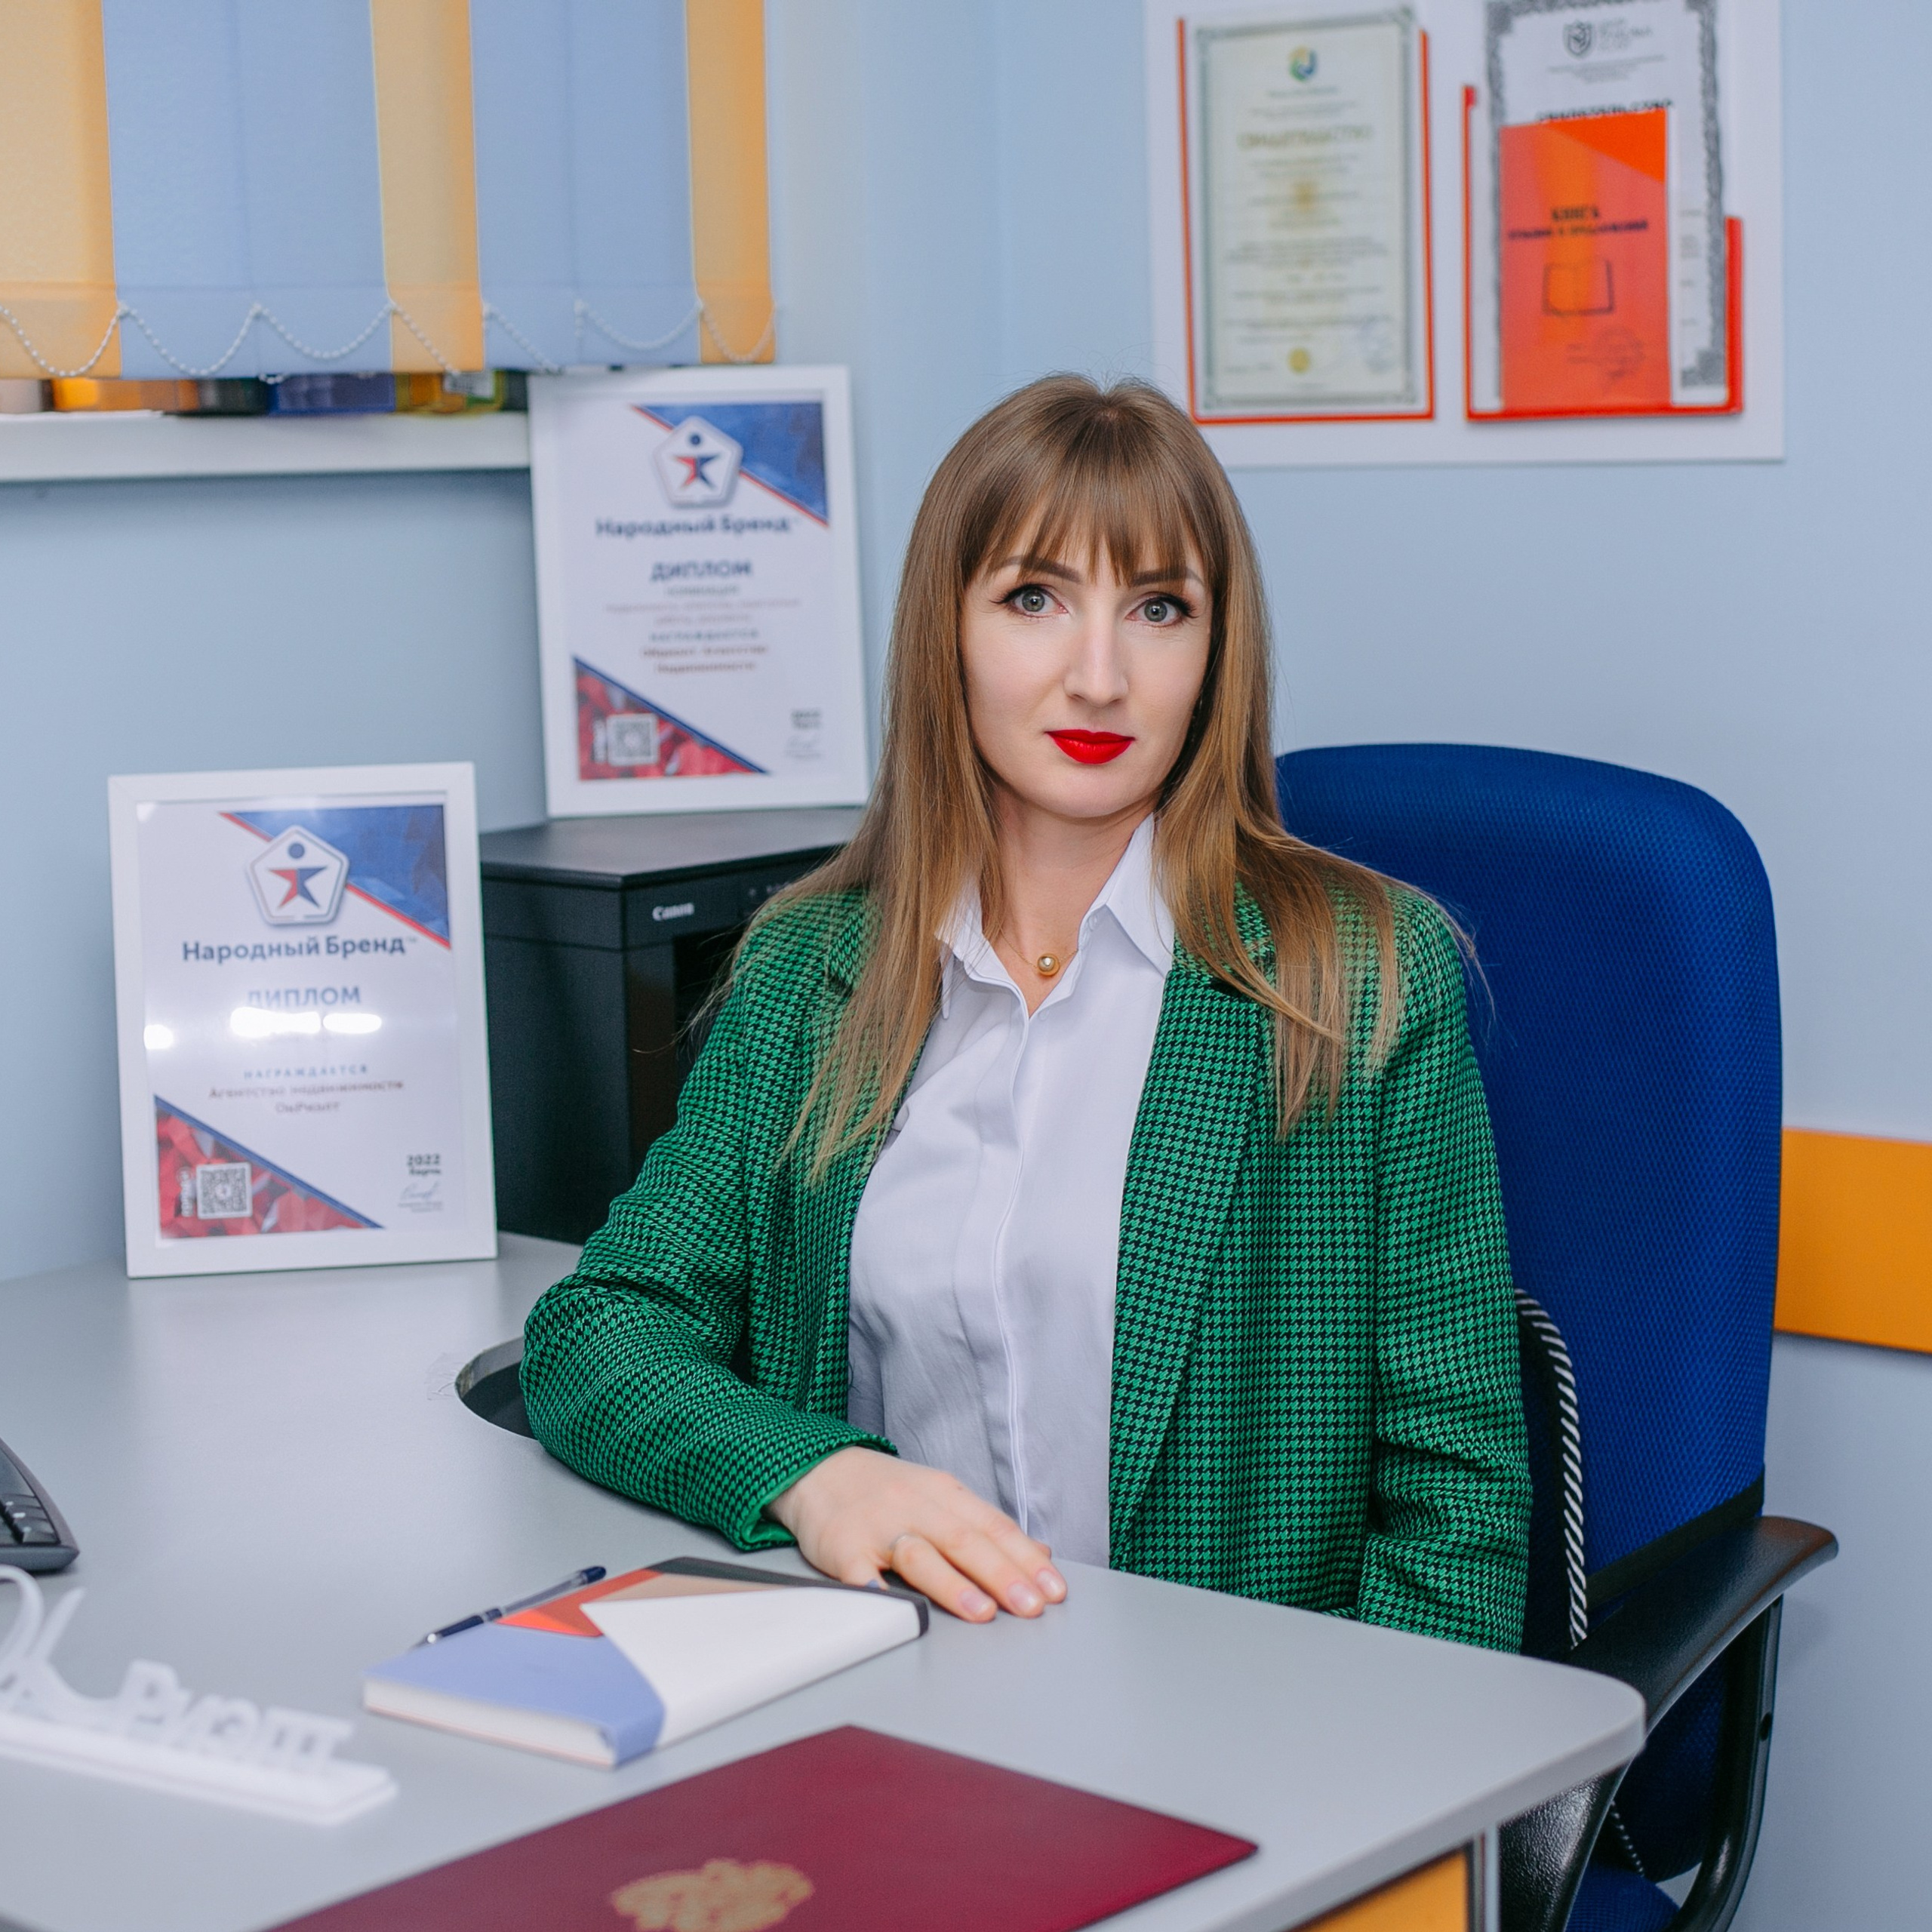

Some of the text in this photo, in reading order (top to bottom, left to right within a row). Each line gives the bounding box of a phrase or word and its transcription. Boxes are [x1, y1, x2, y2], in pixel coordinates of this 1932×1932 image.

[595, 515, 715, 539] Народный
[650, 560, 752, 583] ДИПЛОМ
[652, 903, 694, 921] Canon
[182, 936, 320, 965] Народный
[248, 985, 361, 1008] ДИПЛОМ
[243, 1063, 368, 1080] НАГРАЖДАЕТСЯ
[407, 1153, 441, 1167] 2022
